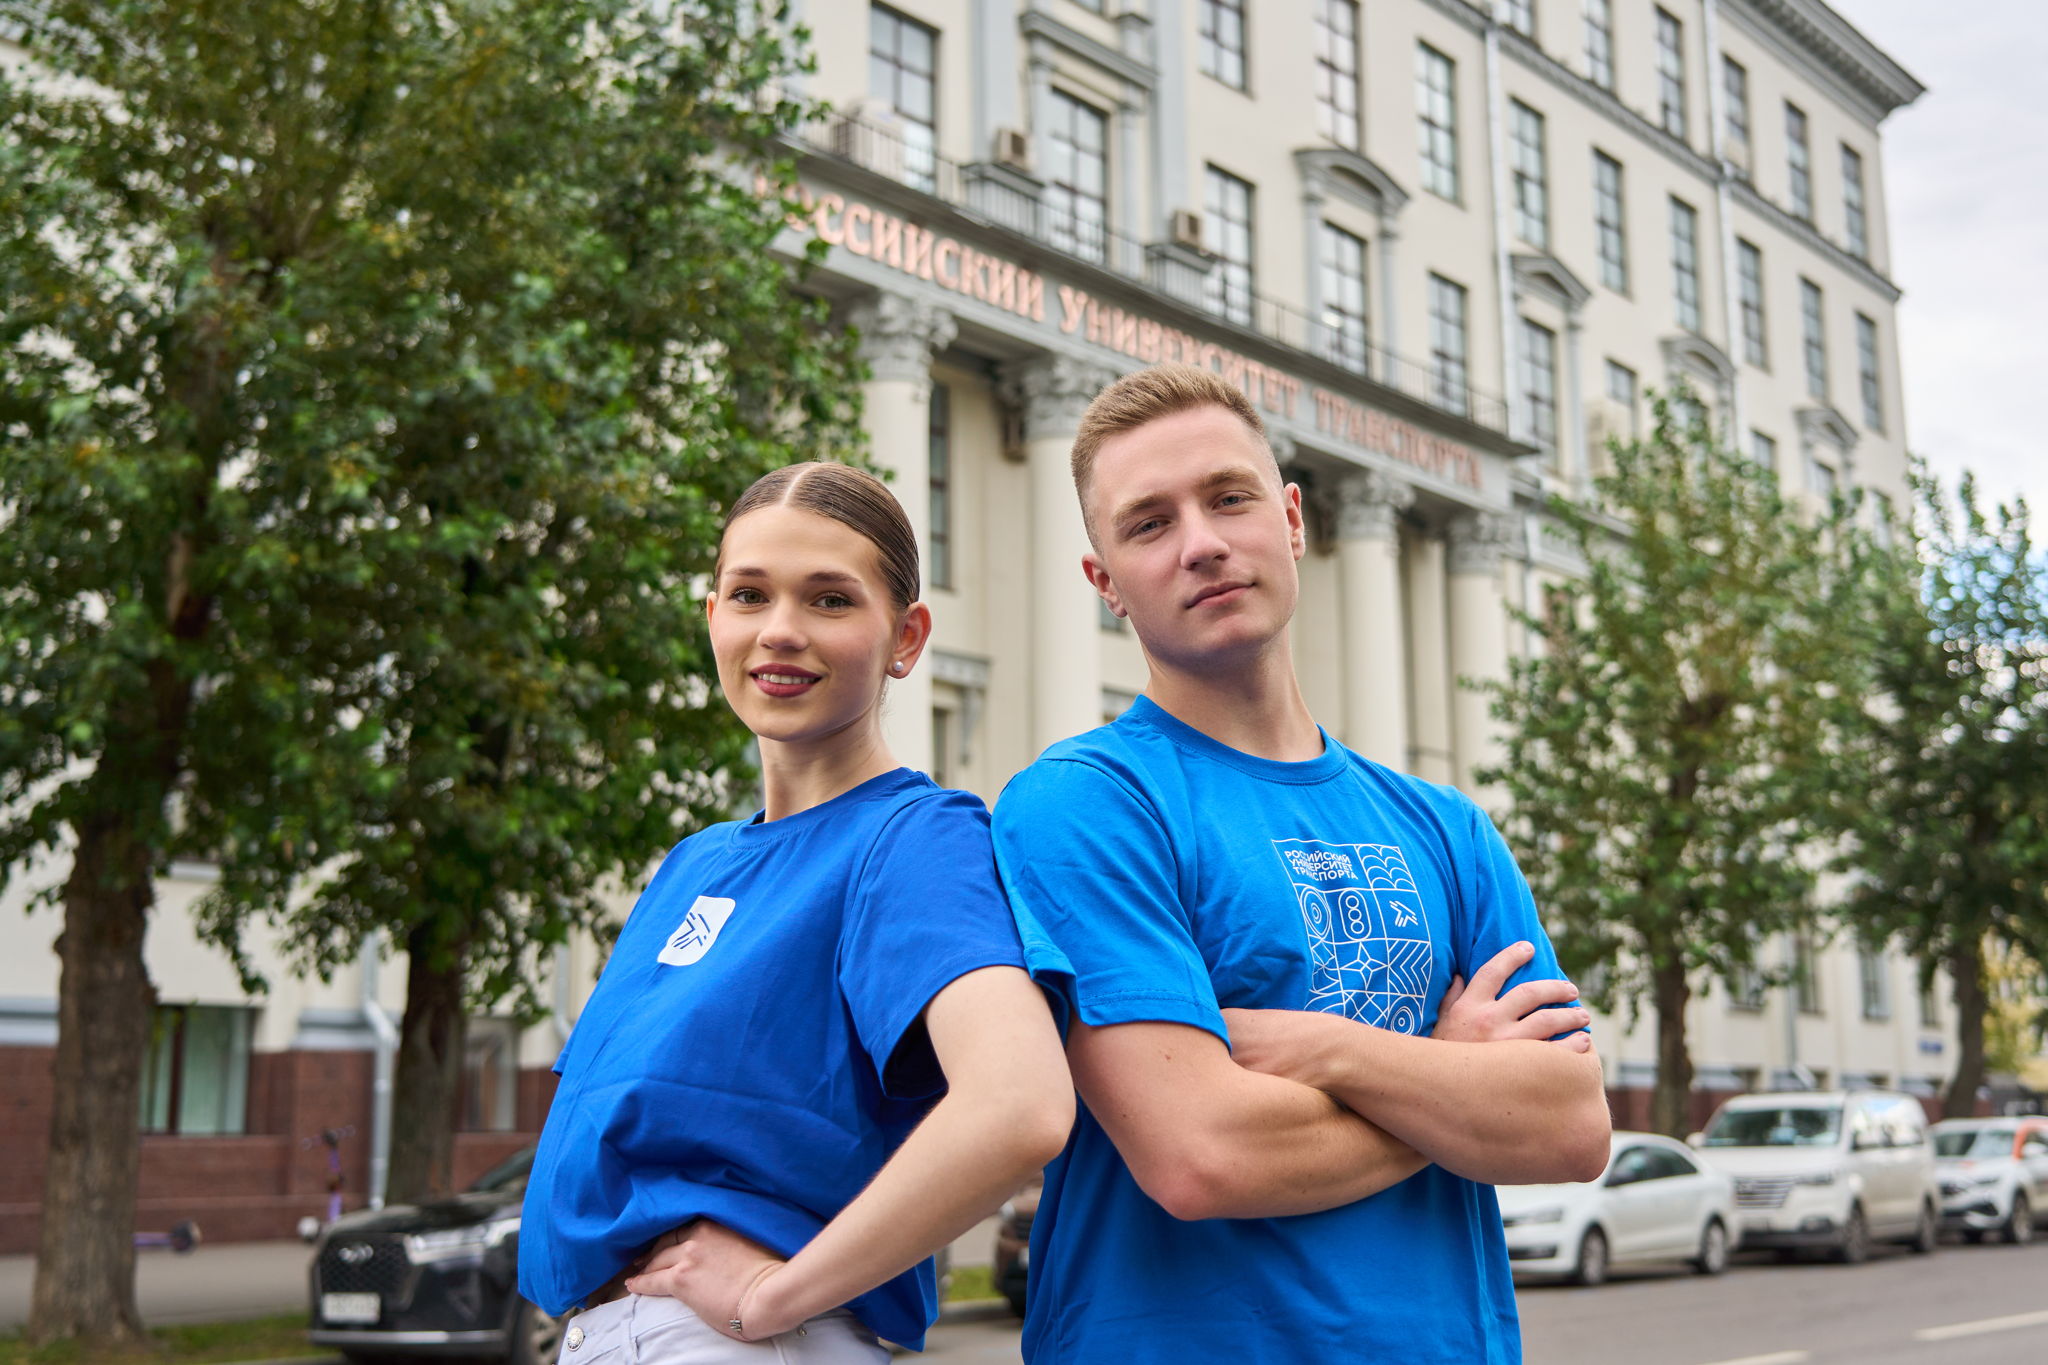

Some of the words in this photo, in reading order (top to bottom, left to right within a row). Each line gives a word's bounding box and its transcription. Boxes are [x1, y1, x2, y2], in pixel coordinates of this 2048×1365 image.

[1312, 385, 1484, 490] ТРАНСПОРТА
[1284, 850, 1351, 864] РОСИЙСКИЙ
[1288, 858, 1353, 872] УНЕРСИТЕТ
[1292, 866, 1359, 881] ТРСПОРТА
